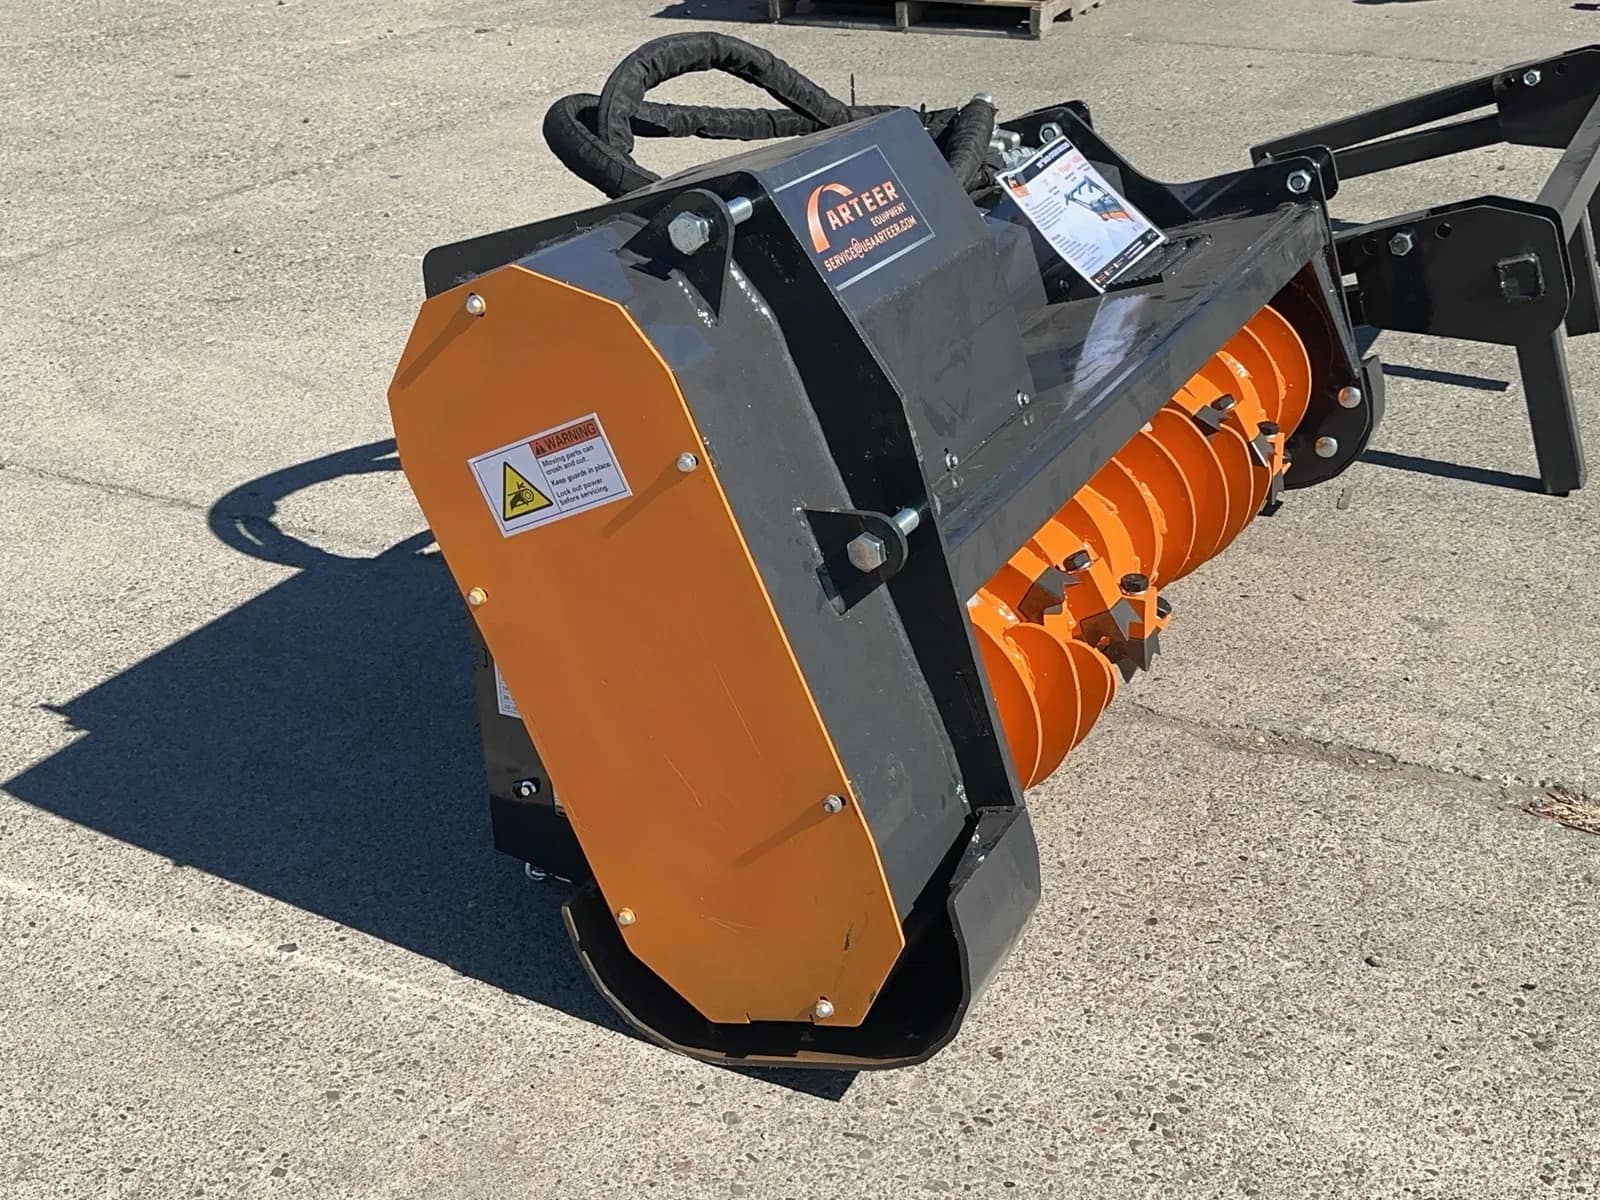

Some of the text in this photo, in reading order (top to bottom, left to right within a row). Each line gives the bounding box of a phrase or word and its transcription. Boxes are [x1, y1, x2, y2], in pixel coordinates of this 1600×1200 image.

[826, 180, 899, 231] ARTEER
[870, 202, 907, 227] EQUIPMENT
[823, 215, 918, 272] SERVICE@USAARTEER.COM
[544, 422, 597, 450] WARNING
[542, 445, 594, 467] Moving parts can
[546, 464, 563, 475] crush
[564, 460, 576, 469] and
[551, 477, 566, 487] Keep
[567, 469, 587, 482] guards
[556, 478, 603, 498] Lock out power
[559, 494, 580, 505] before
